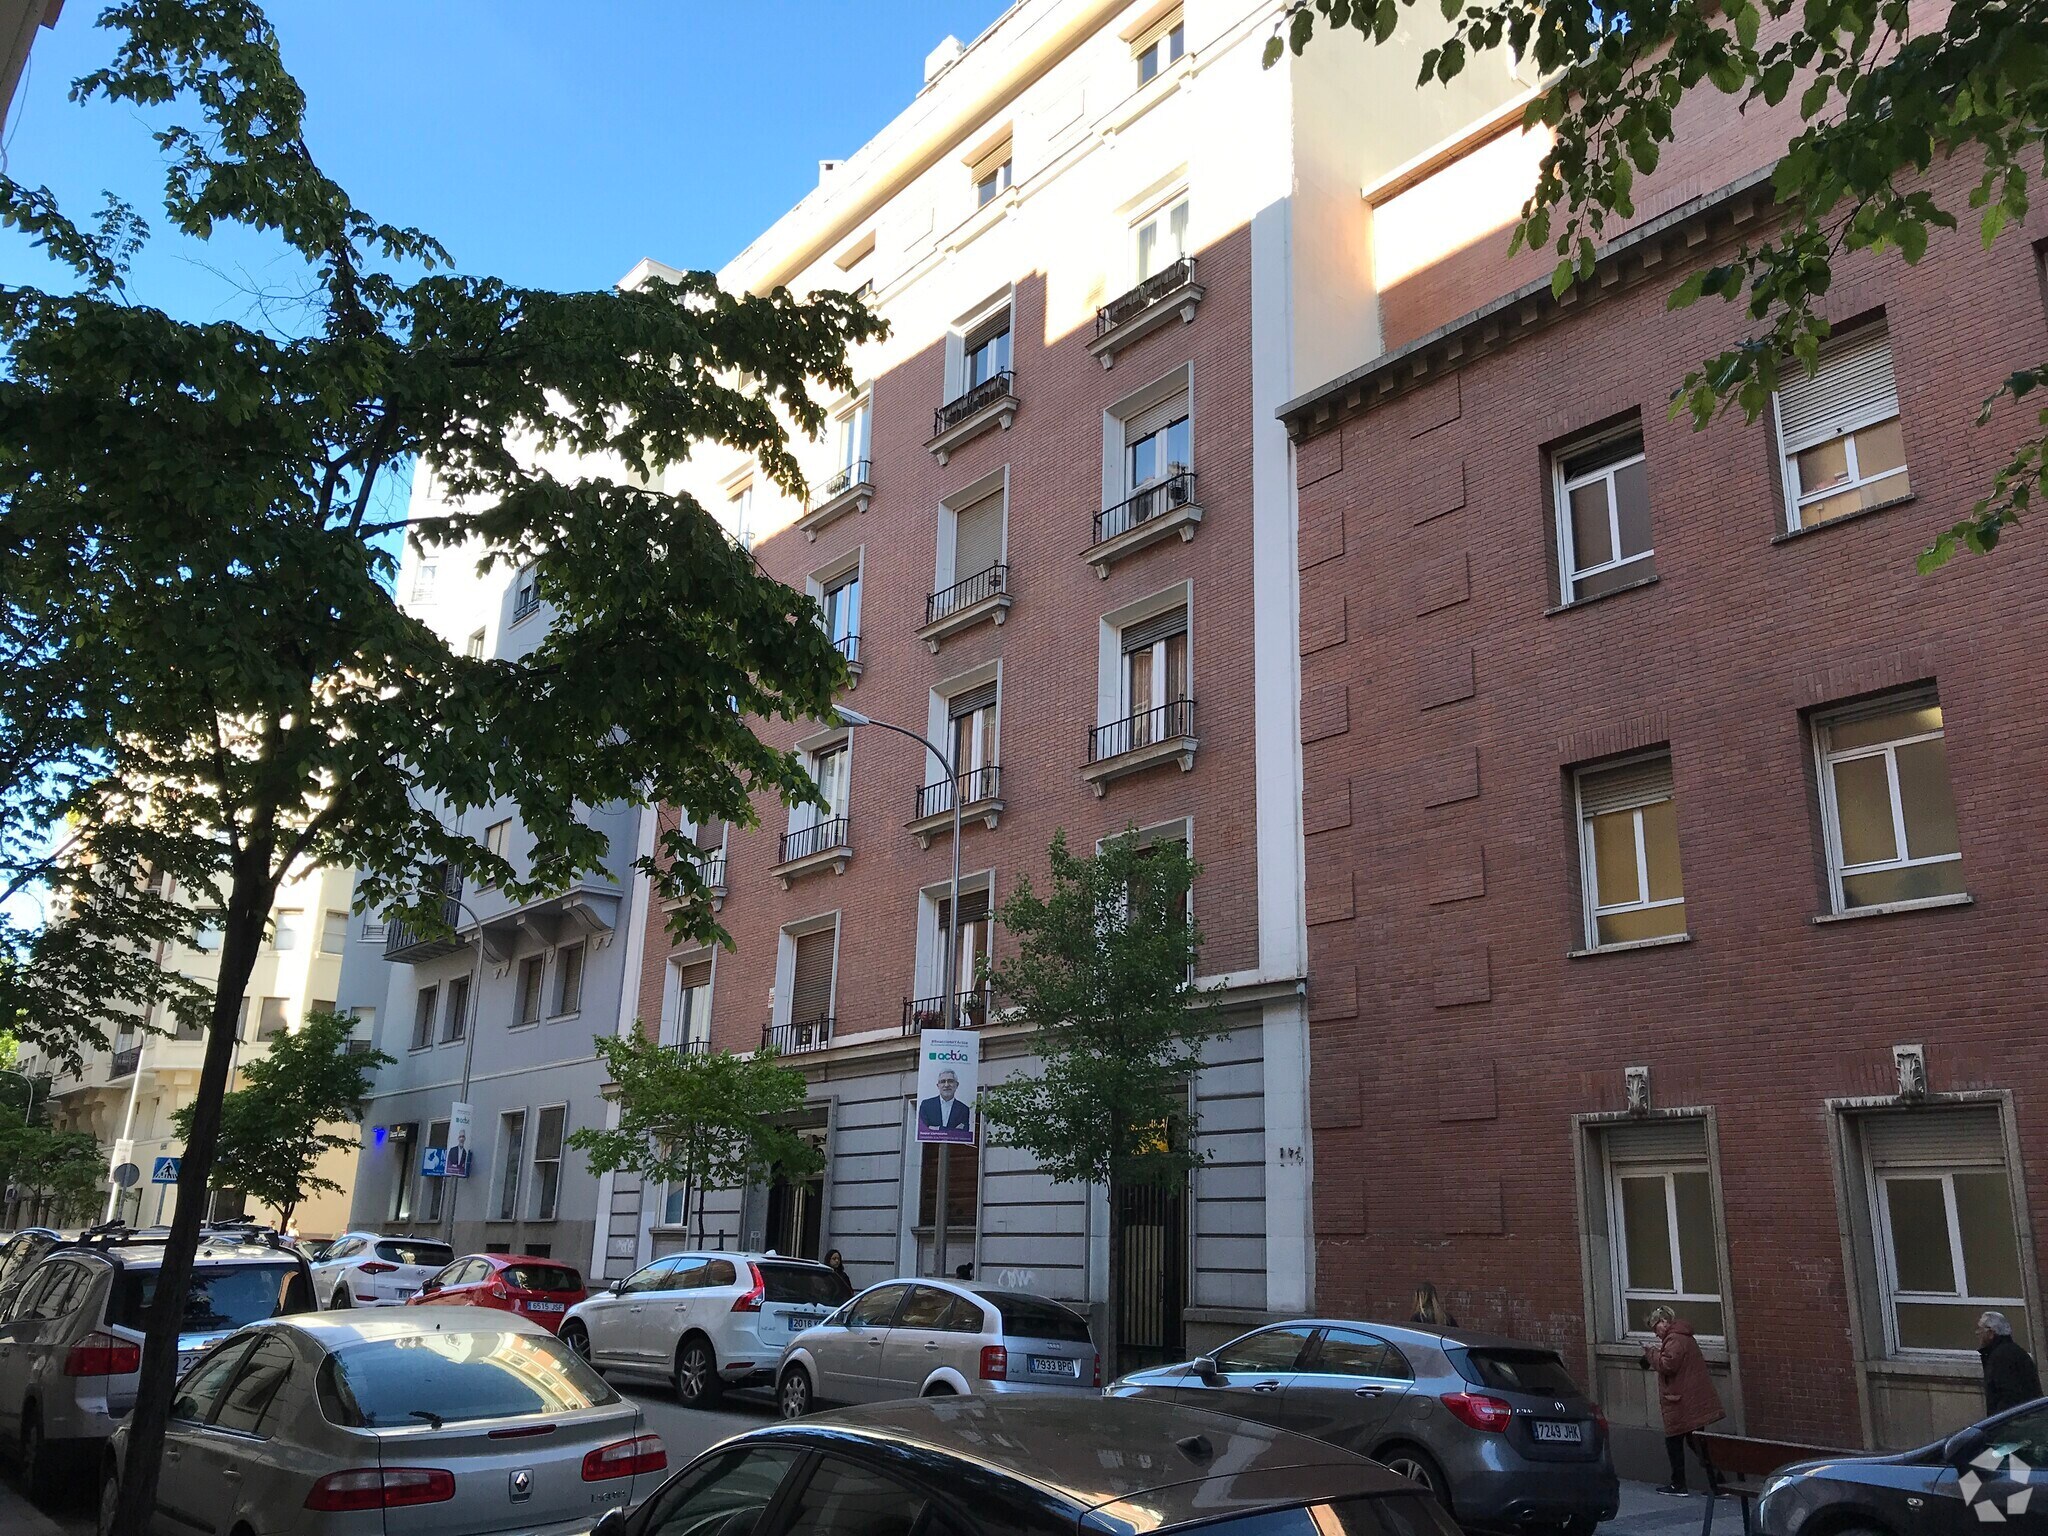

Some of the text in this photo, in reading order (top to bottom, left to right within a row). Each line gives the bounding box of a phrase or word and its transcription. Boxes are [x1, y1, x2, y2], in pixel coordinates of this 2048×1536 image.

[937, 1049, 968, 1062] actúa
[1036, 1360, 1073, 1372] 7933 BPG
[1539, 1424, 1579, 1439] 7249 JHK
